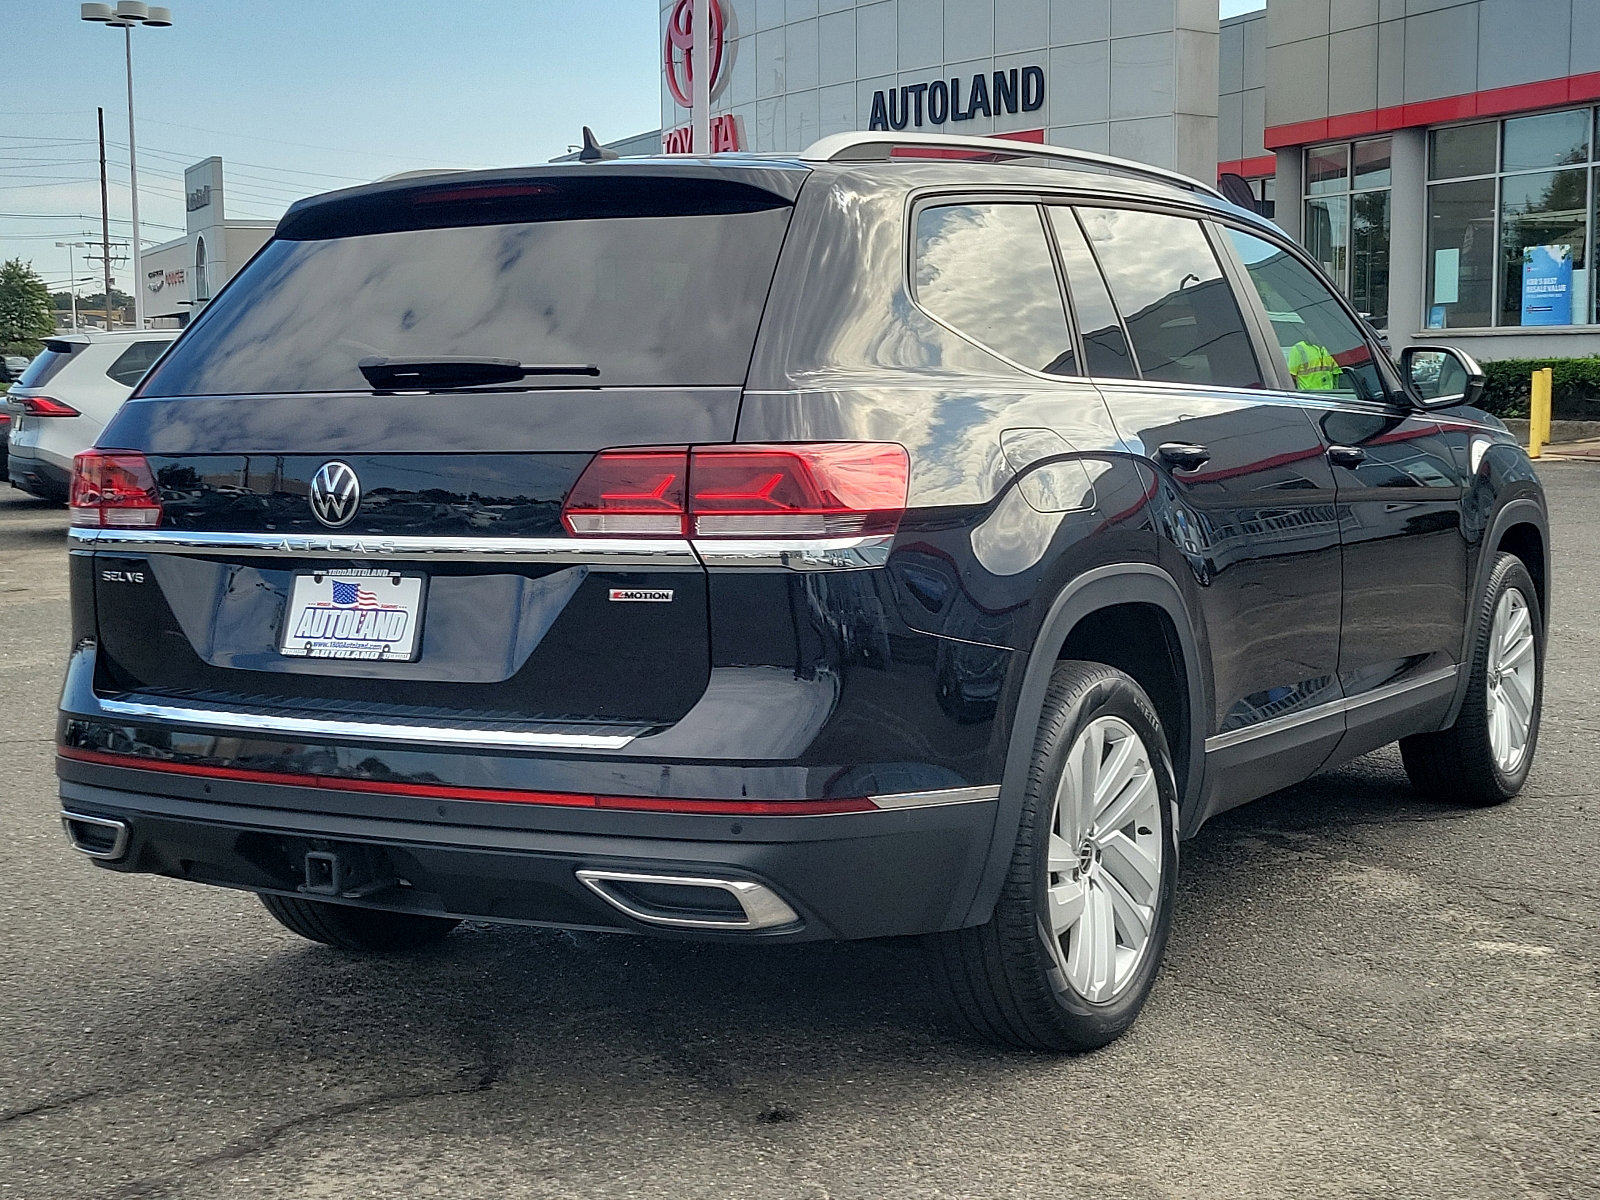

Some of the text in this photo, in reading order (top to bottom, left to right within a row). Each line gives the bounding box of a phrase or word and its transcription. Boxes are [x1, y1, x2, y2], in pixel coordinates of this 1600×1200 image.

[868, 66, 1045, 132] AUTOLAND
[662, 113, 739, 154] TOYTA
[278, 538, 396, 554] ATLAS
[101, 570, 126, 582] SEL
[294, 606, 409, 643] AUTOLAND
[312, 650, 380, 659] AUTOLAND
